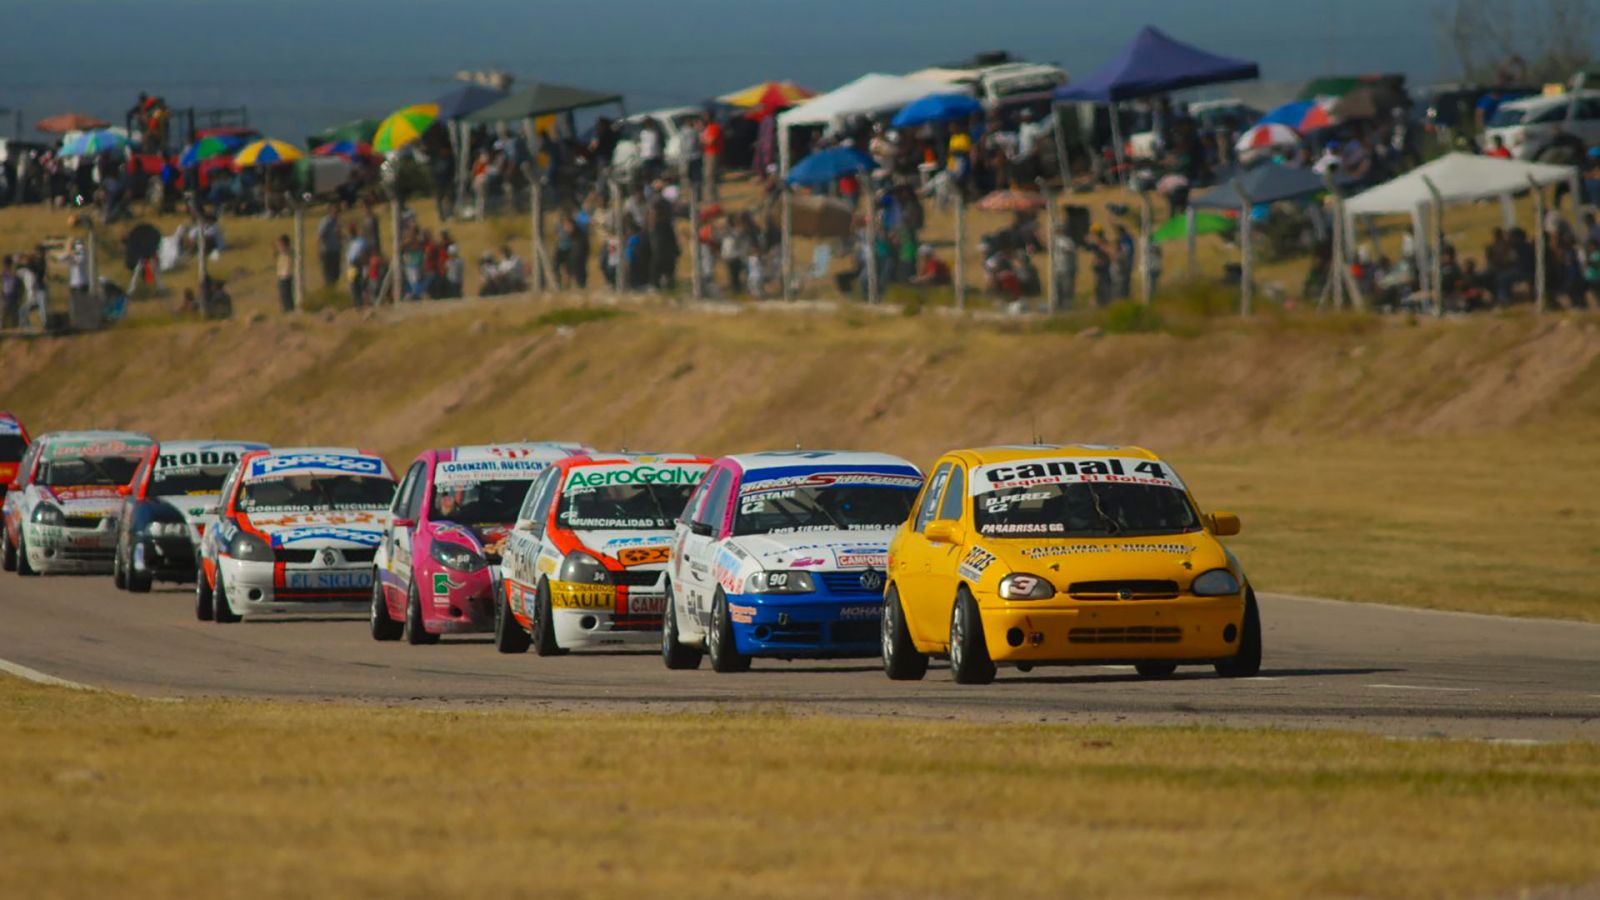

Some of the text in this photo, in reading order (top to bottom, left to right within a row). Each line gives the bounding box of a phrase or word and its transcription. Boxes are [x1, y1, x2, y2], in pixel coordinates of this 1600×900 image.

[986, 459, 1168, 482] canal 4
[567, 466, 707, 490] AeroGalv
[993, 475, 1060, 489] Esquel
[742, 490, 796, 505] BESTANI
[741, 502, 764, 515] C2
[988, 504, 1008, 514] C2
[570, 518, 653, 527] MUNICIPALIDAD
[318, 574, 371, 588] SIGLO
[768, 573, 788, 587] 90
[1009, 576, 1038, 596] 3
